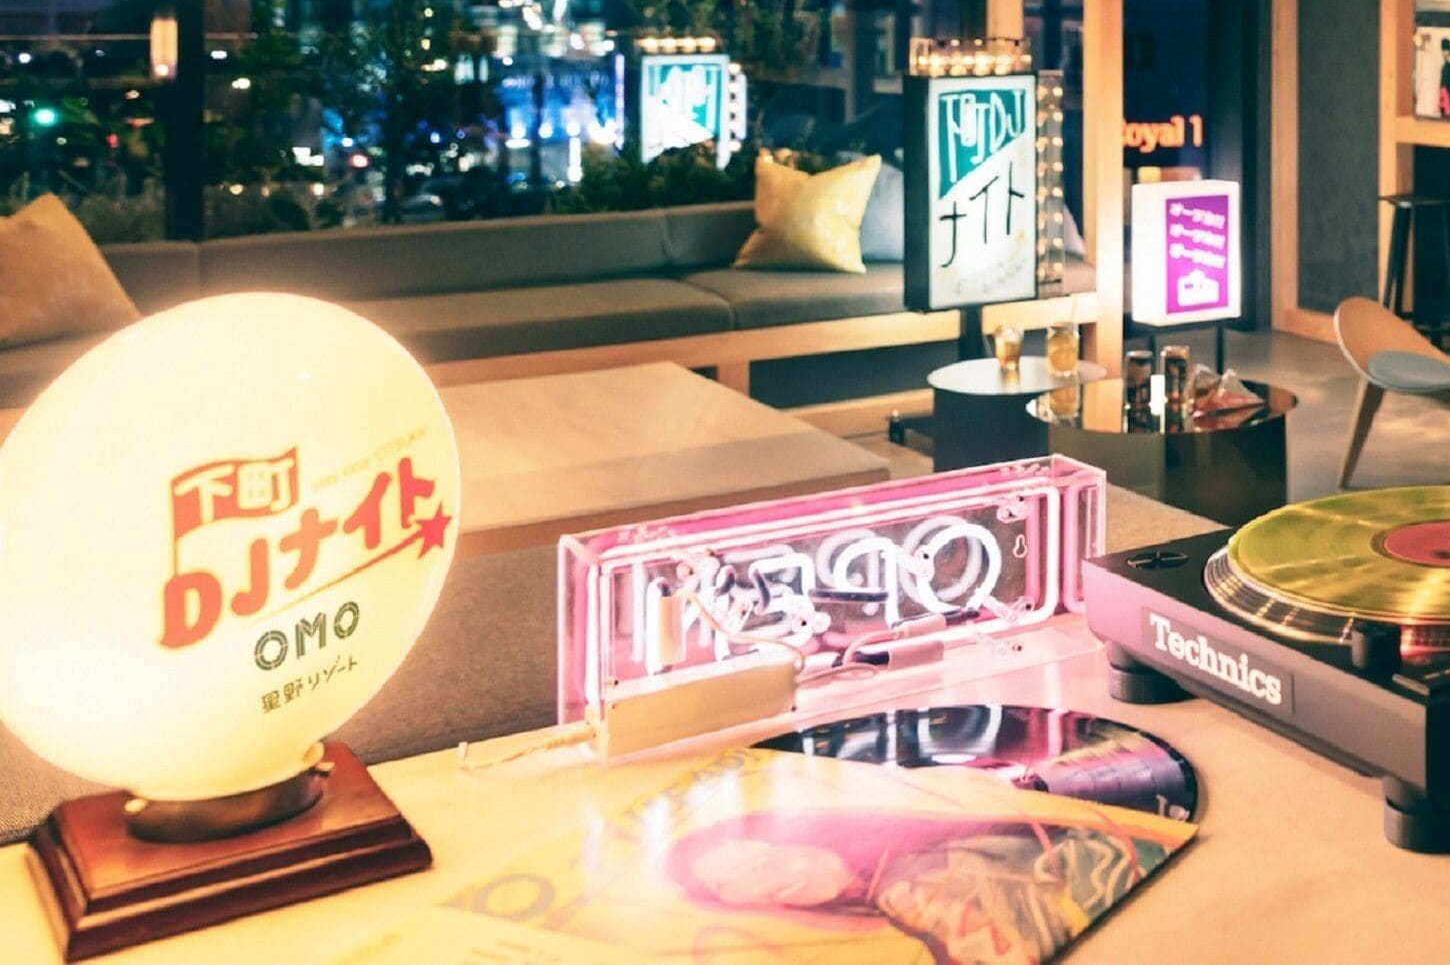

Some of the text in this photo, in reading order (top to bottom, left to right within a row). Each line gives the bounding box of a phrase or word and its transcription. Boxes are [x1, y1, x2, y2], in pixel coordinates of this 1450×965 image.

[1122, 114, 1185, 154] oyal
[939, 161, 1025, 269] ナイト
[173, 457, 297, 526] 下町
[159, 456, 436, 650] DJナイト
[254, 600, 360, 671] OMO
[1149, 611, 1282, 706] Technics
[261, 654, 359, 714] 星野リゾート
